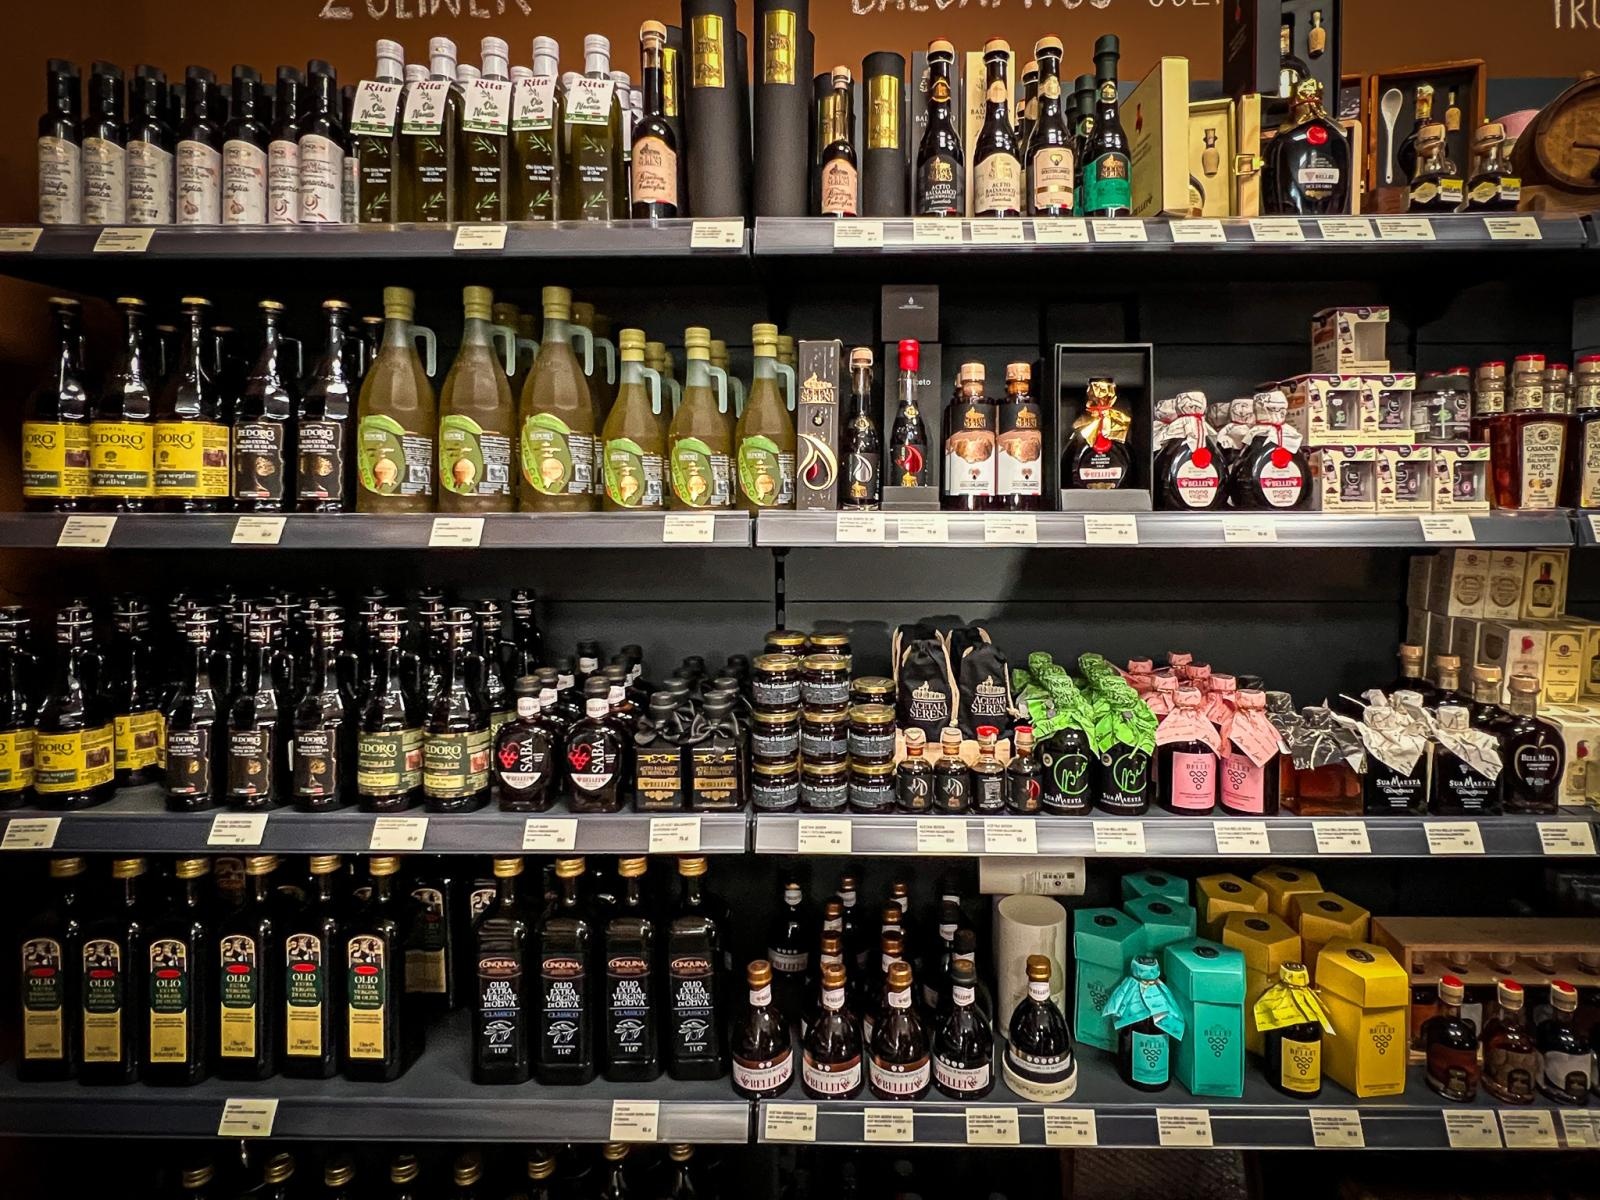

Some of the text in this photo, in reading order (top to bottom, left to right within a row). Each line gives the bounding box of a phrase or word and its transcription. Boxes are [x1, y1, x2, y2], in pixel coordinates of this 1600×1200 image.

[364, 83, 394, 93] Rita
[416, 80, 443, 90] Rita
[474, 80, 503, 91] Rita
[523, 79, 550, 88] Rita
[578, 80, 605, 89] Rita
[1188, 479, 1209, 487] BELLEI
[1271, 479, 1292, 487] BELLEI
[520, 738, 533, 772] SABA
[591, 739, 605, 773] SABA
[1061, 761, 1088, 792] Bio
[1121, 760, 1146, 791] Bio
[482, 960, 516, 969] CINQUINA
[546, 961, 580, 969] CINQUINA
[611, 960, 644, 969] CINQUINA
[675, 960, 708, 968] CINQUINA
[30, 978, 56, 986] OLIO
[226, 974, 250, 983] OLIO
[292, 973, 316, 982] OLIO
[354, 976, 378, 984] OLIO
[89, 979, 115, 987] OLIO
[156, 979, 181, 988] OLIO
[619, 980, 639, 988] OLIO
[546, 994, 580, 1002] VERGINE
[491, 1000, 515, 1008] OLIVA
[751, 1072, 782, 1090] BELLEI
[939, 1071, 967, 1090] BELLEI
[811, 1079, 841, 1093] BELLEI
[883, 1079, 914, 1093] BELLEI
